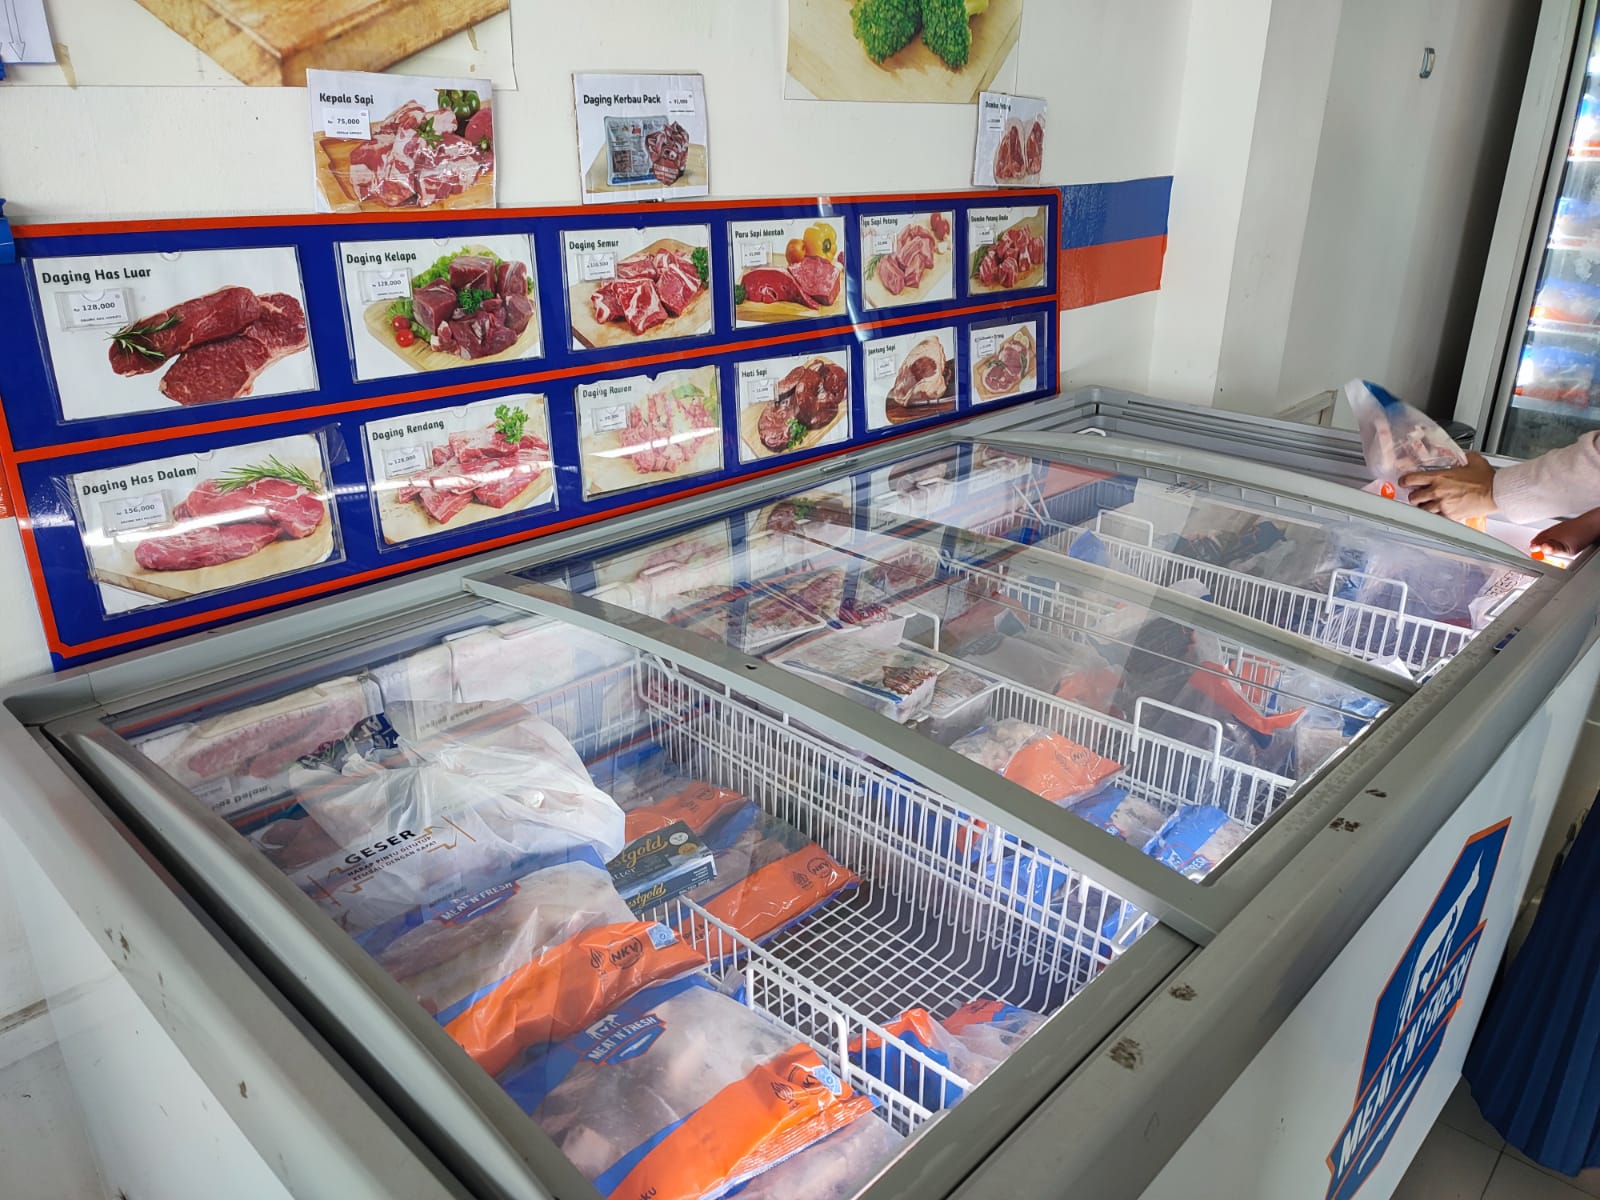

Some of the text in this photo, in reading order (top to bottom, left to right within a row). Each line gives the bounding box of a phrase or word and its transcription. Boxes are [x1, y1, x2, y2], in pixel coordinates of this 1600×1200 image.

[319, 92, 375, 106] Kepala Sapi
[583, 94, 661, 107] Daging Kerbau Pack
[336, 118, 360, 126] 75,000
[735, 230, 749, 239] Paru
[749, 229, 762, 239] Sapi
[569, 239, 619, 252] Daging Semur
[346, 251, 417, 266] Daging Kelapa
[42, 267, 152, 286] Daging Has Luar
[82, 301, 116, 312] 128,000
[742, 368, 768, 378] Hati Sapi
[582, 388, 608, 399] Daging
[372, 420, 445, 441] Daging Rendang
[82, 466, 198, 496] Daging Has Dalam
[123, 504, 156, 515] 156,000
[344, 829, 416, 865] GESER
[440, 902, 470, 921] MEAT
[611, 941, 640, 963] NKV
[588, 1038, 617, 1060] MEAT
[622, 1016, 657, 1034] FRESH
[1337, 1043, 1403, 1179] MEAT
[1425, 942, 1476, 1034] FRESH
